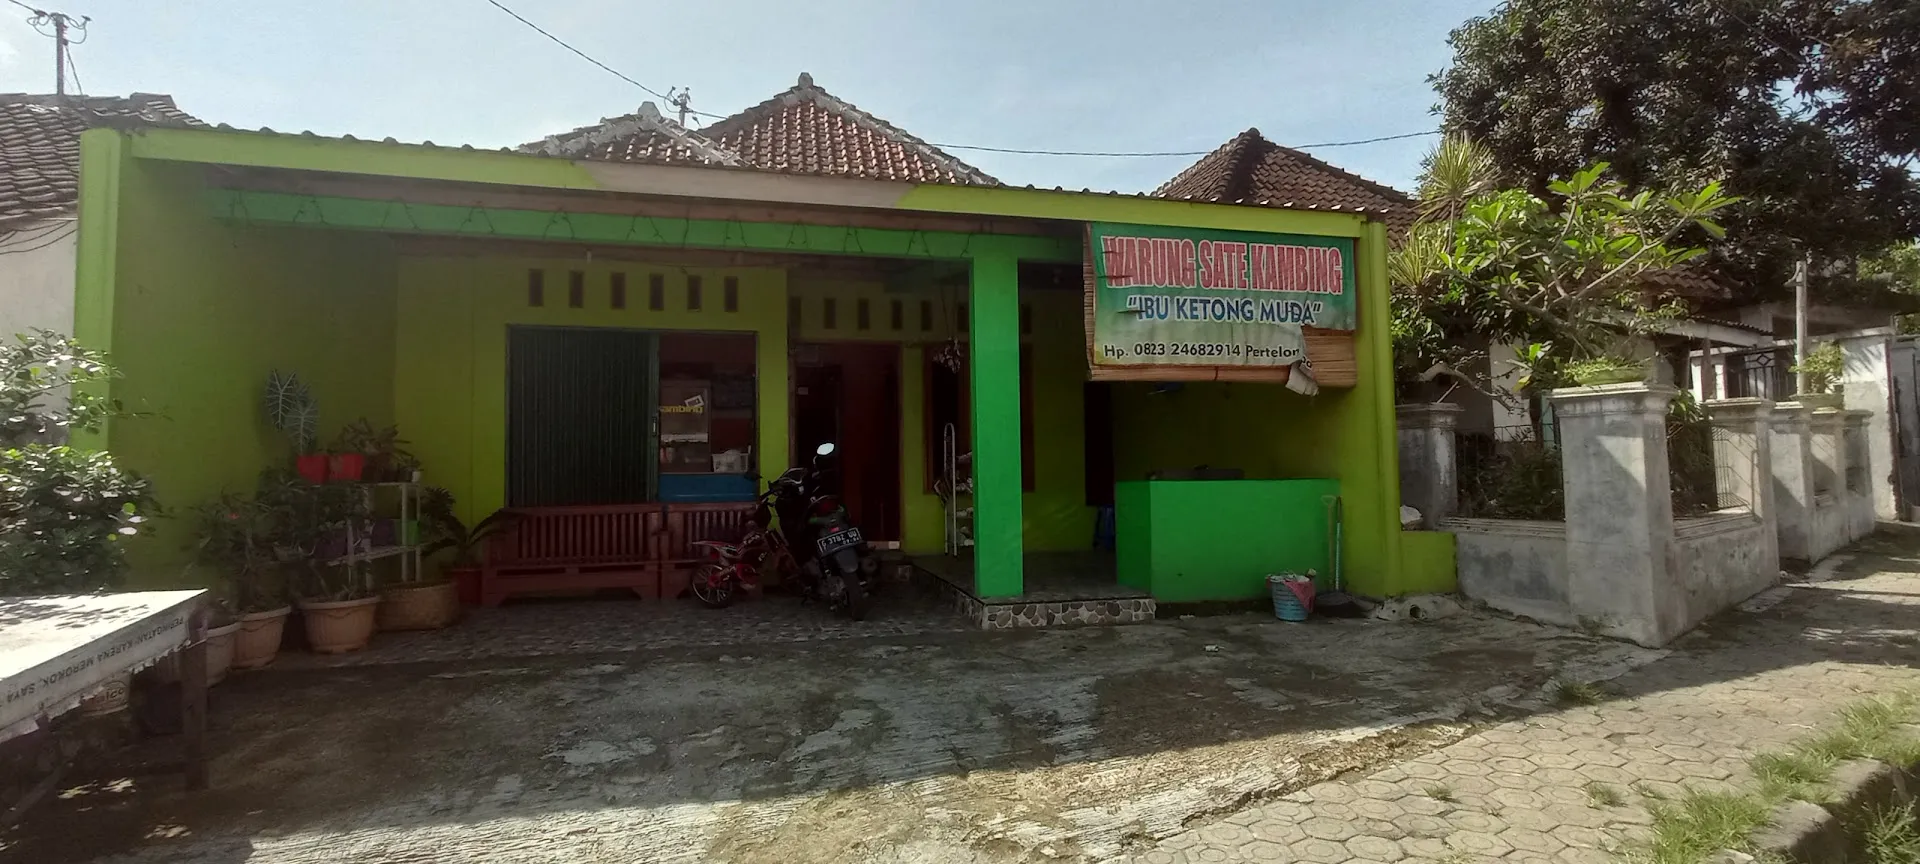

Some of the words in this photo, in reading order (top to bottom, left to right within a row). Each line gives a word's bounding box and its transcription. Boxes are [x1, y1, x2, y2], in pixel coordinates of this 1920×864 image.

[1101, 236, 1197, 289] WARUNG
[1198, 240, 1248, 290] SATE
[1250, 244, 1343, 294] KAMBING
[1176, 298, 1254, 322] KETONG
[1104, 345, 1129, 360] Hp.
[1134, 343, 1165, 356] 0823
[1171, 343, 1241, 357] 24682914
[97, 638, 134, 662] KARENA
[7, 683, 36, 703] SAYA
